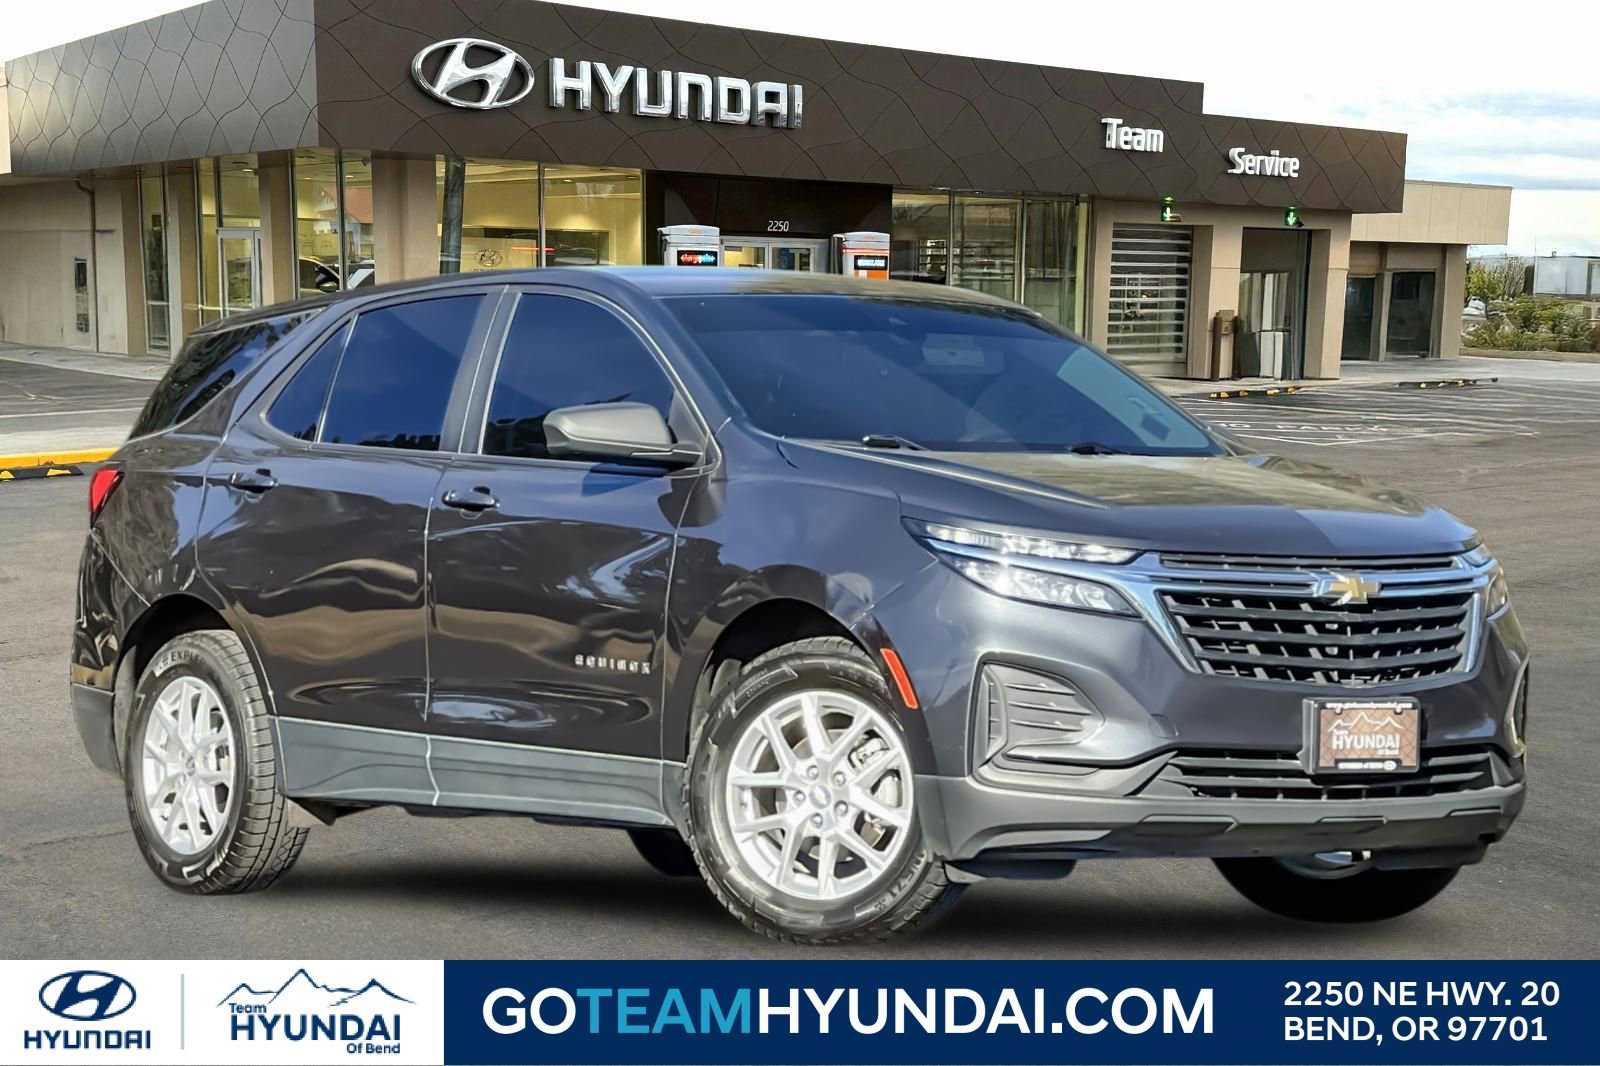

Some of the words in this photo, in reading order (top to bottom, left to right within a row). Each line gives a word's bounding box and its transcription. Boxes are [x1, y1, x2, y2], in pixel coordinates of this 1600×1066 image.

[548, 57, 803, 129] HYUNDAI
[1101, 117, 1164, 153] Team
[1227, 147, 1300, 178] Service
[767, 220, 790, 233] 2250
[1332, 733, 1400, 750] HYUNDAI
